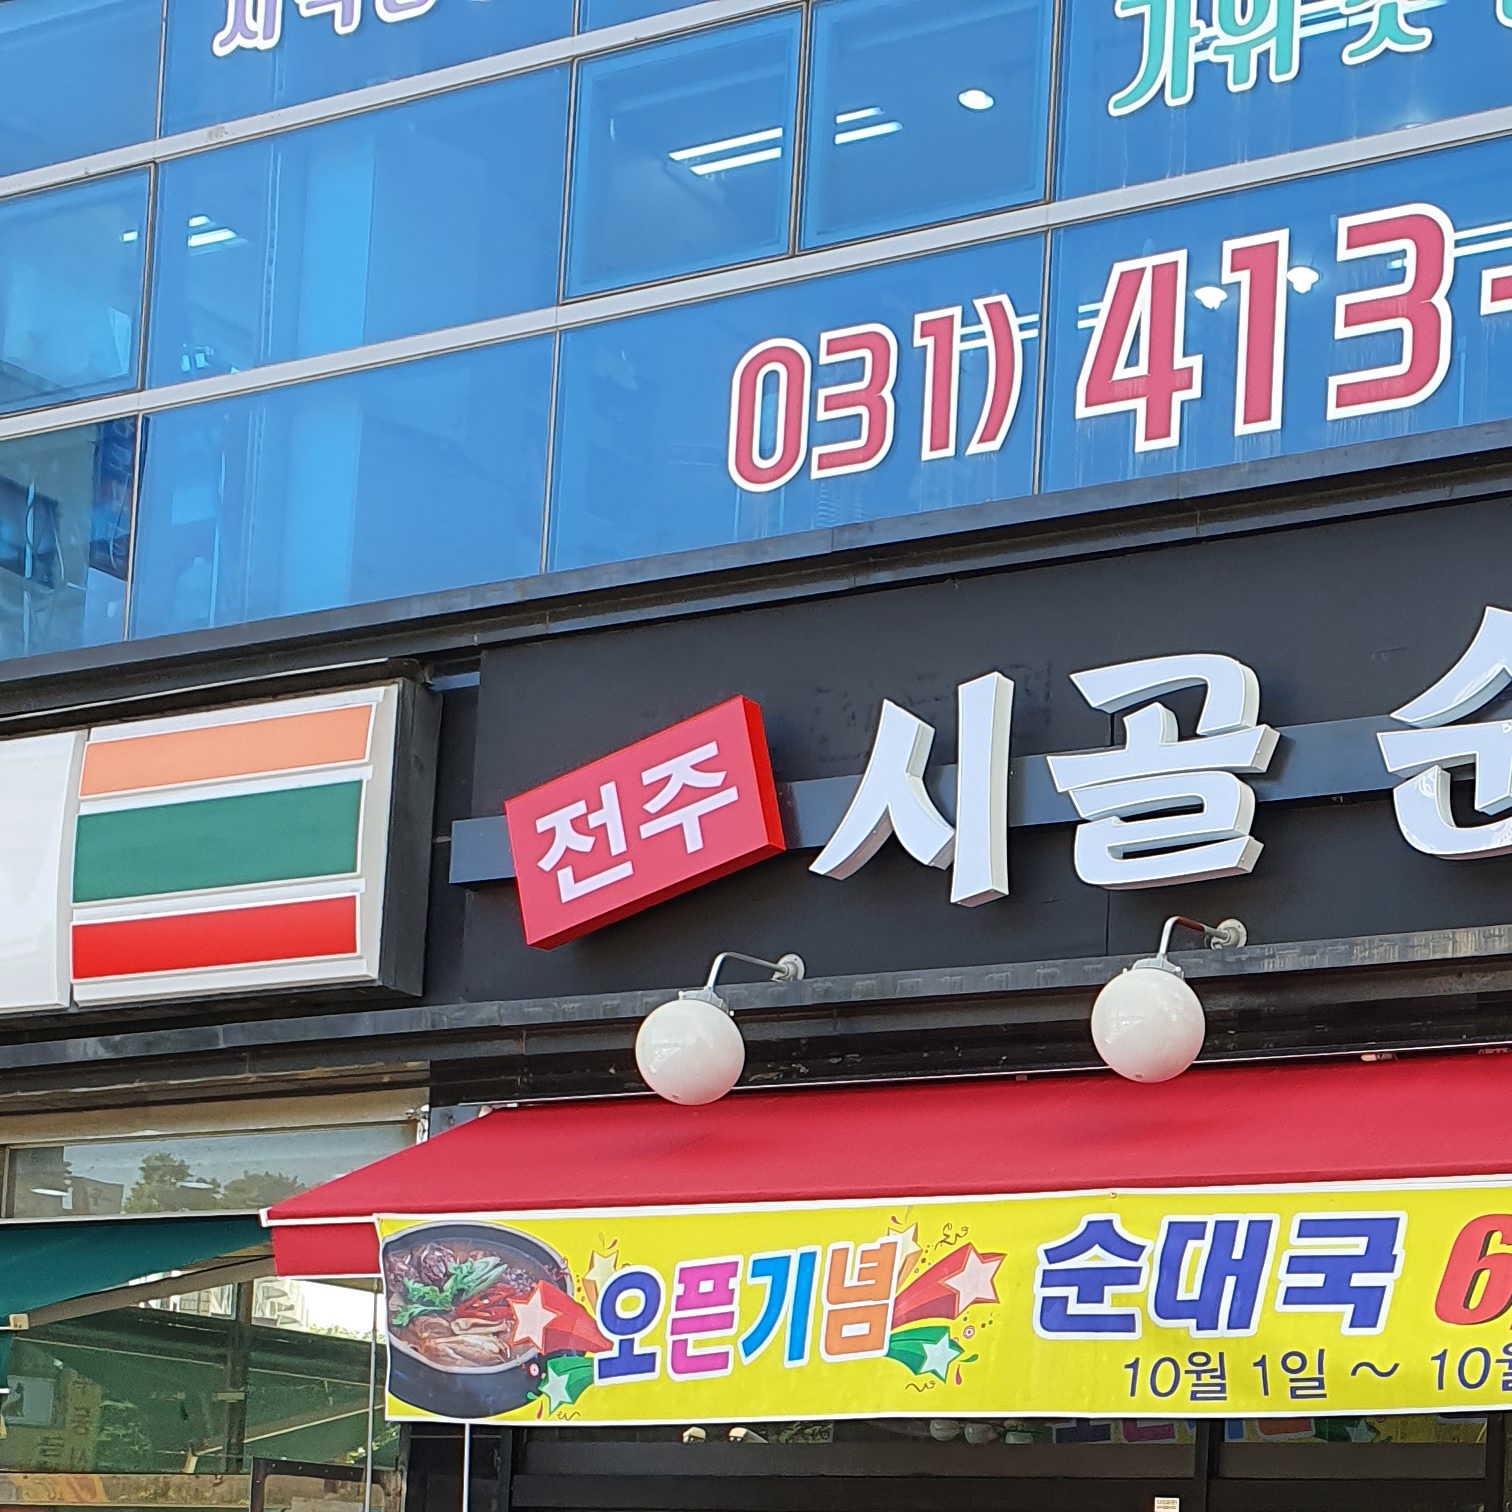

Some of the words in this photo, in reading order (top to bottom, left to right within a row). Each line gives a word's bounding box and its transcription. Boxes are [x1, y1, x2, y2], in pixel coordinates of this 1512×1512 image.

[728, 294, 1024, 493] 031)
[534, 740, 741, 904] 전주
[808, 653, 1281, 908] 시골
[593, 1238, 900, 1387] 오픈기념
[1032, 1210, 1407, 1341] 순대국
[1124, 1349, 1229, 1404] 10월
[1252, 1349, 1328, 1401] 1일
